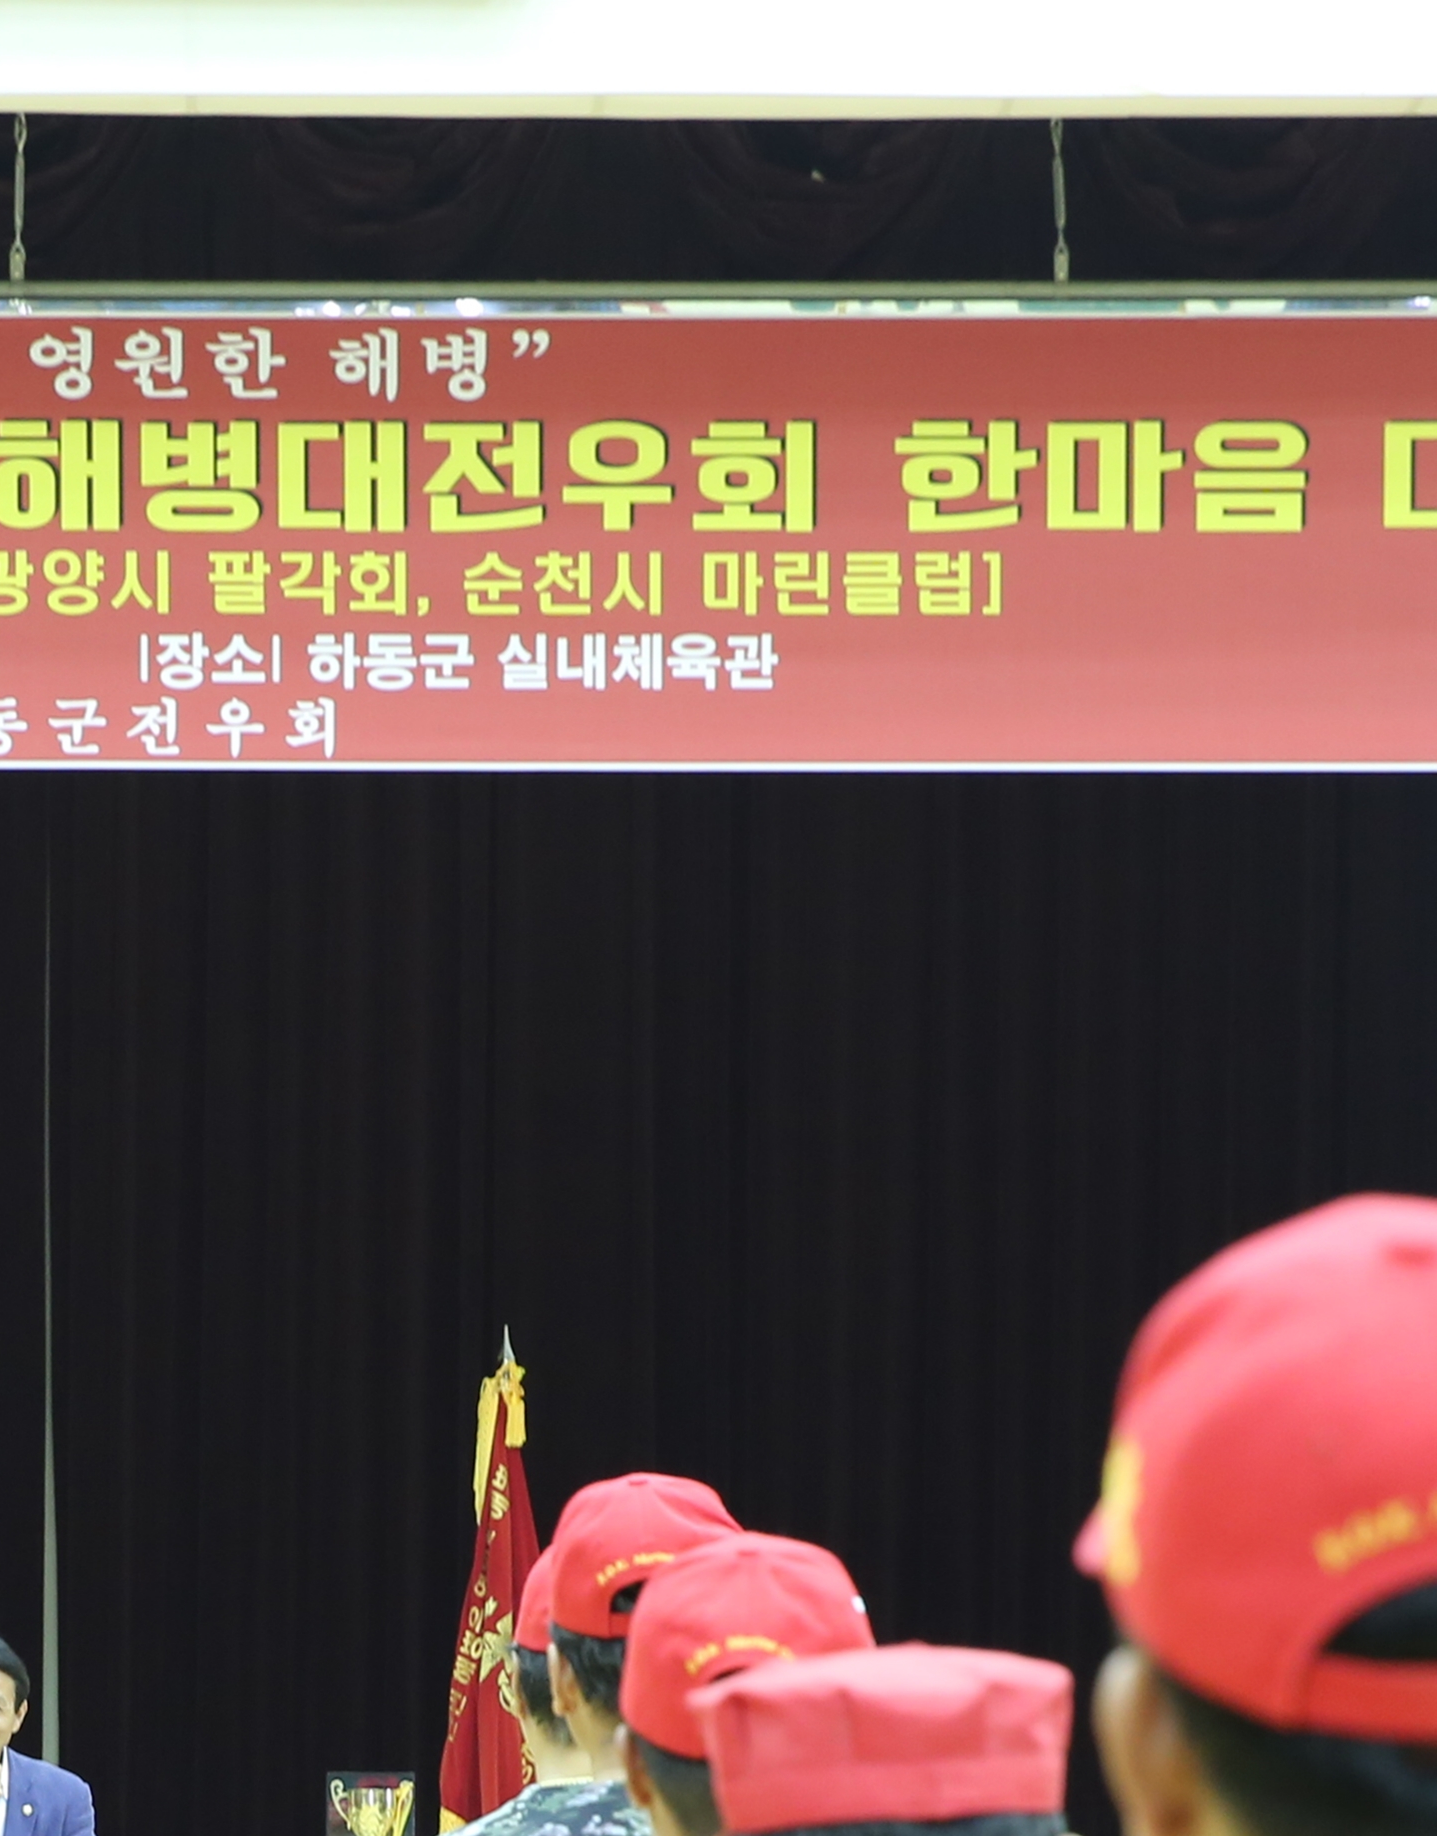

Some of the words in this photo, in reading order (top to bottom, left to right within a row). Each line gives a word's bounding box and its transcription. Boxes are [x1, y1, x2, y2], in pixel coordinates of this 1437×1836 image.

[29, 328, 286, 399] 영원한
[894, 420, 1306, 534] 한마음
[208, 551, 430, 617] 팔각회,
[463, 551, 662, 617] 순천시
[702, 551, 1003, 617] 마린클럽]
[306, 632, 475, 691] 하동군
[497, 633, 780, 691] 실내체육관
